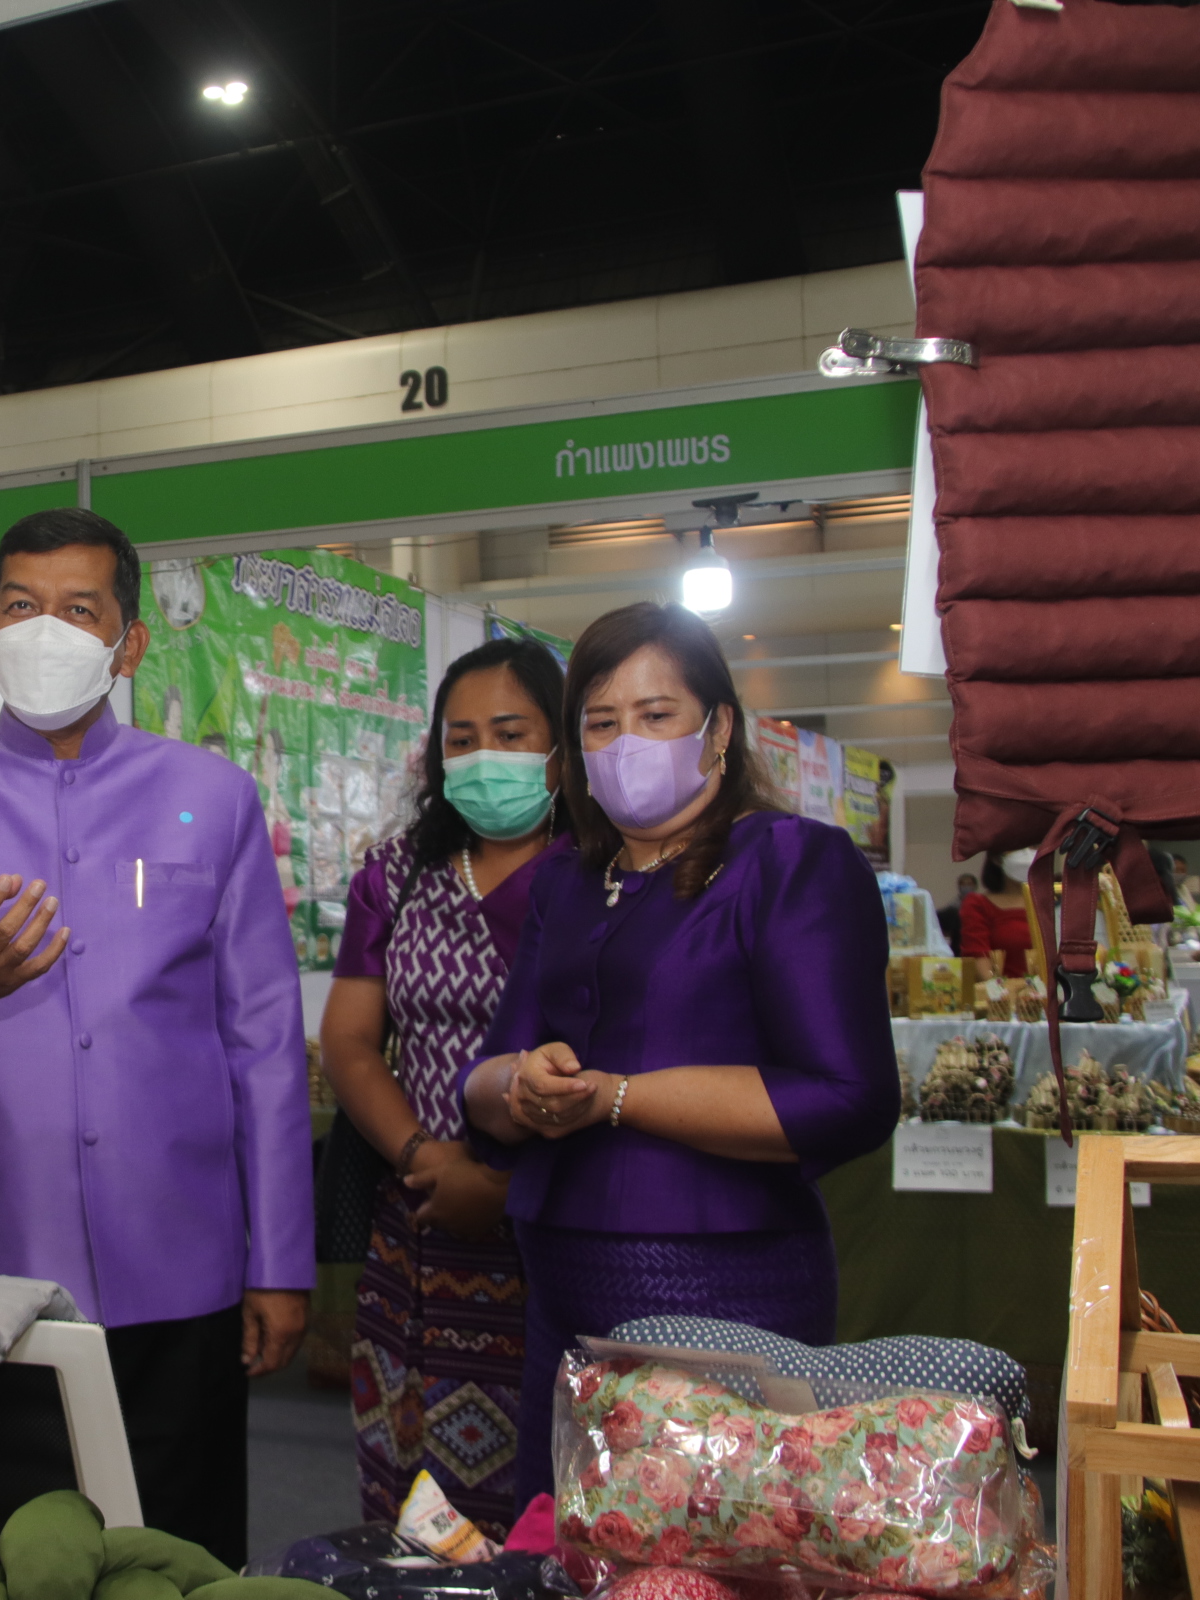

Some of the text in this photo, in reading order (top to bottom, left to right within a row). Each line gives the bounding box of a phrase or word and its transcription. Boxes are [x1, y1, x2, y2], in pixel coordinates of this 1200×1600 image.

[399, 365, 448, 412] 20
[555, 434, 731, 478] กำแพงเพชร
